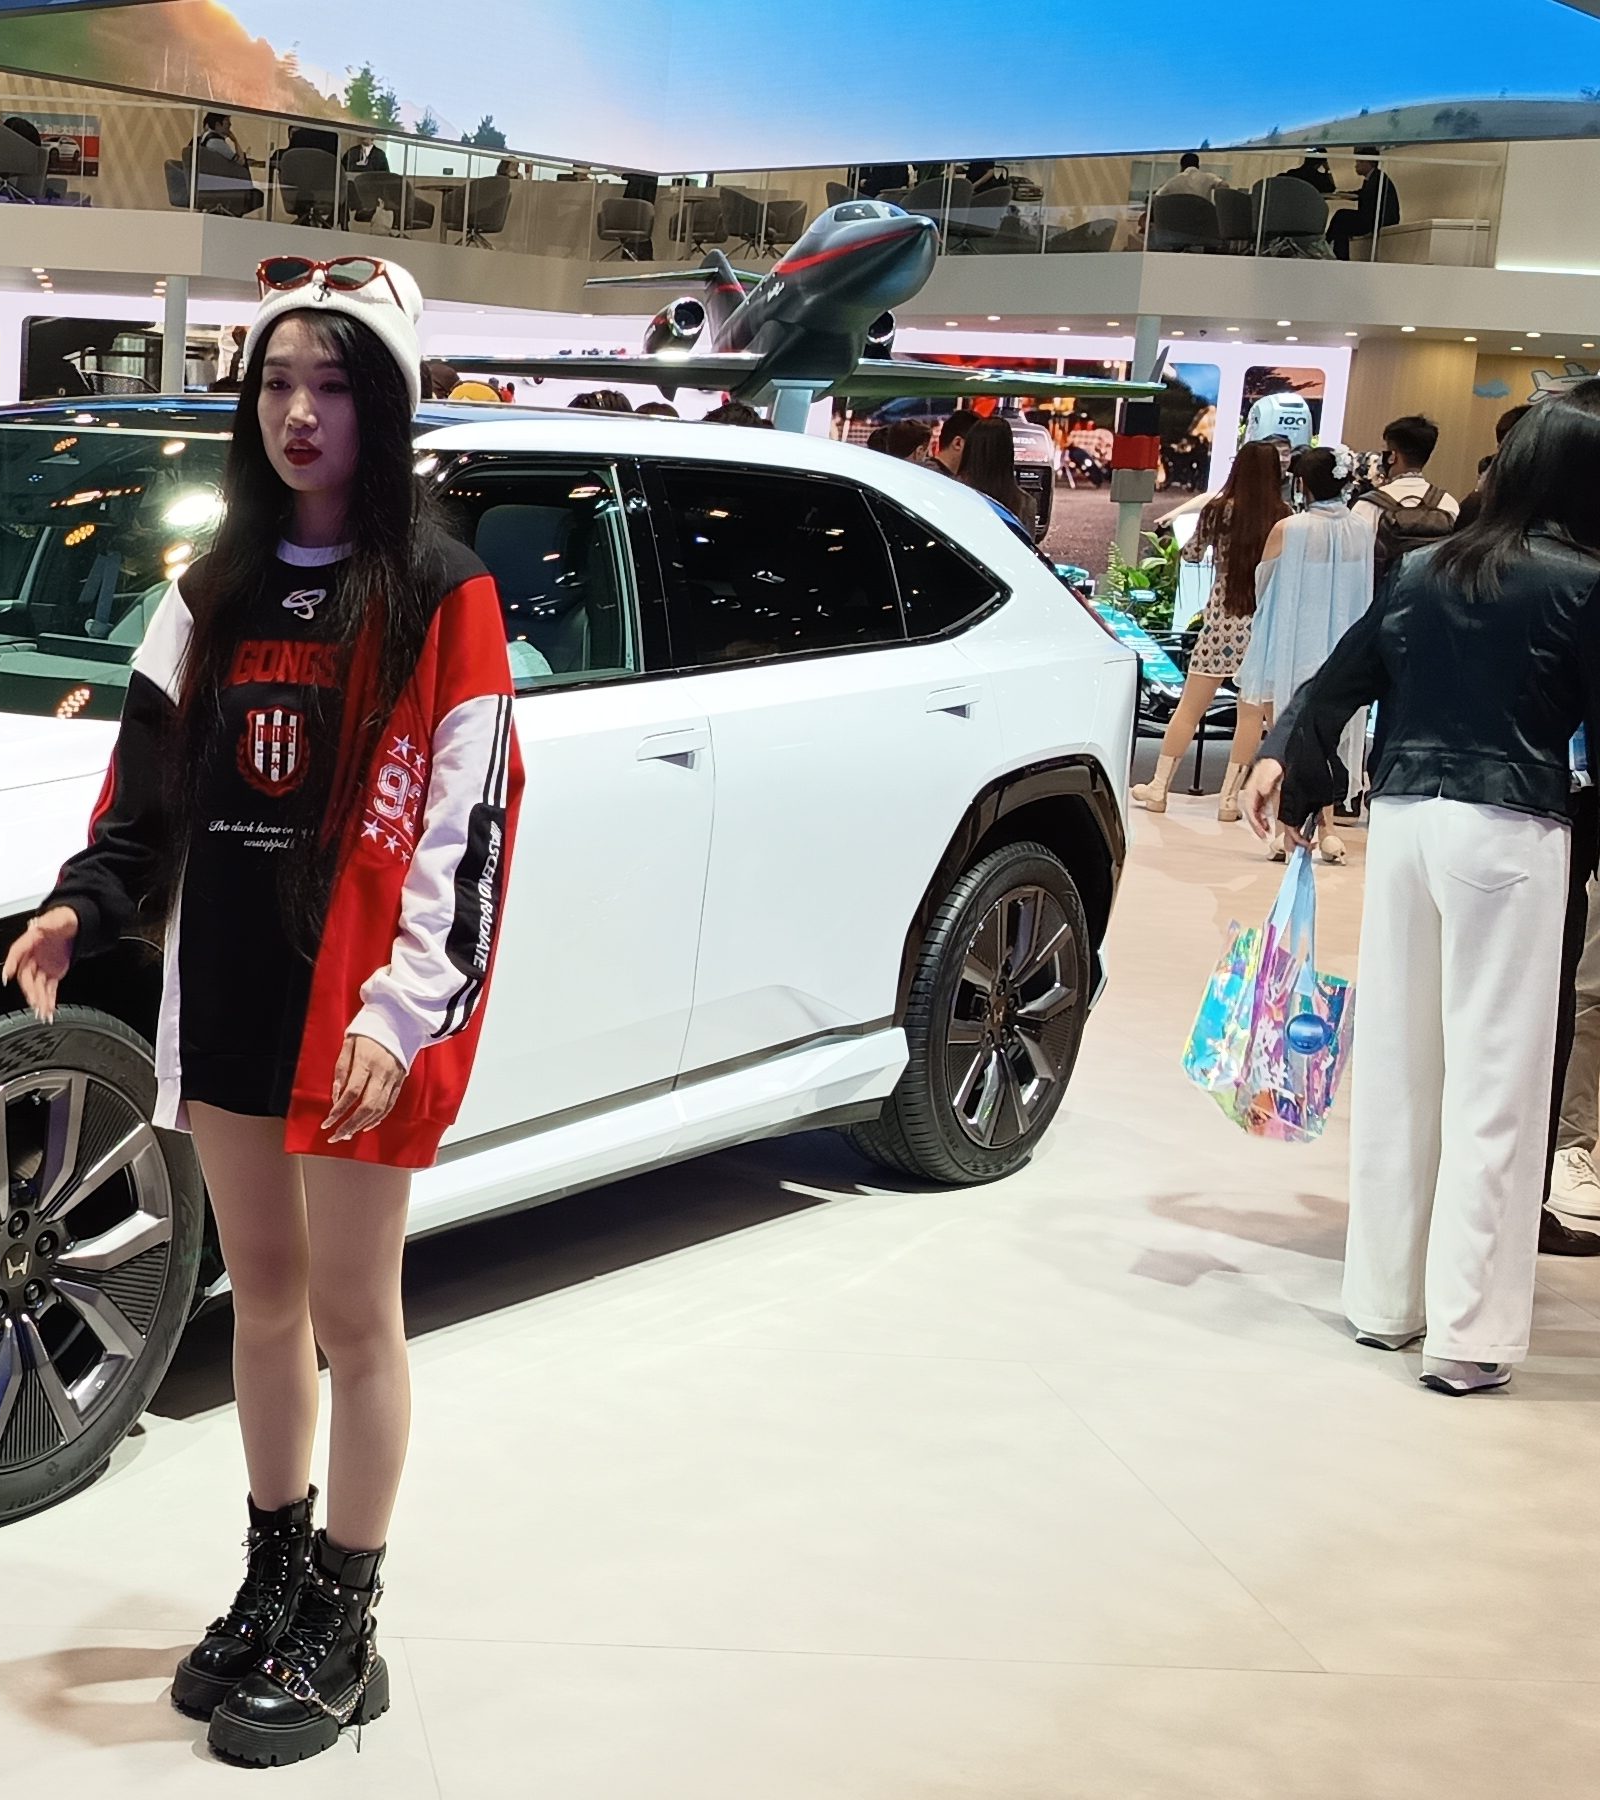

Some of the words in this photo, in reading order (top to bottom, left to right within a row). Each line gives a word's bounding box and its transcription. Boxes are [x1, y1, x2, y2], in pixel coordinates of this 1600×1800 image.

[1278, 416, 1306, 426] 100
[231, 820, 254, 832] dark
[478, 830, 502, 899] ASCEND
[473, 898, 494, 972] RADIATE
